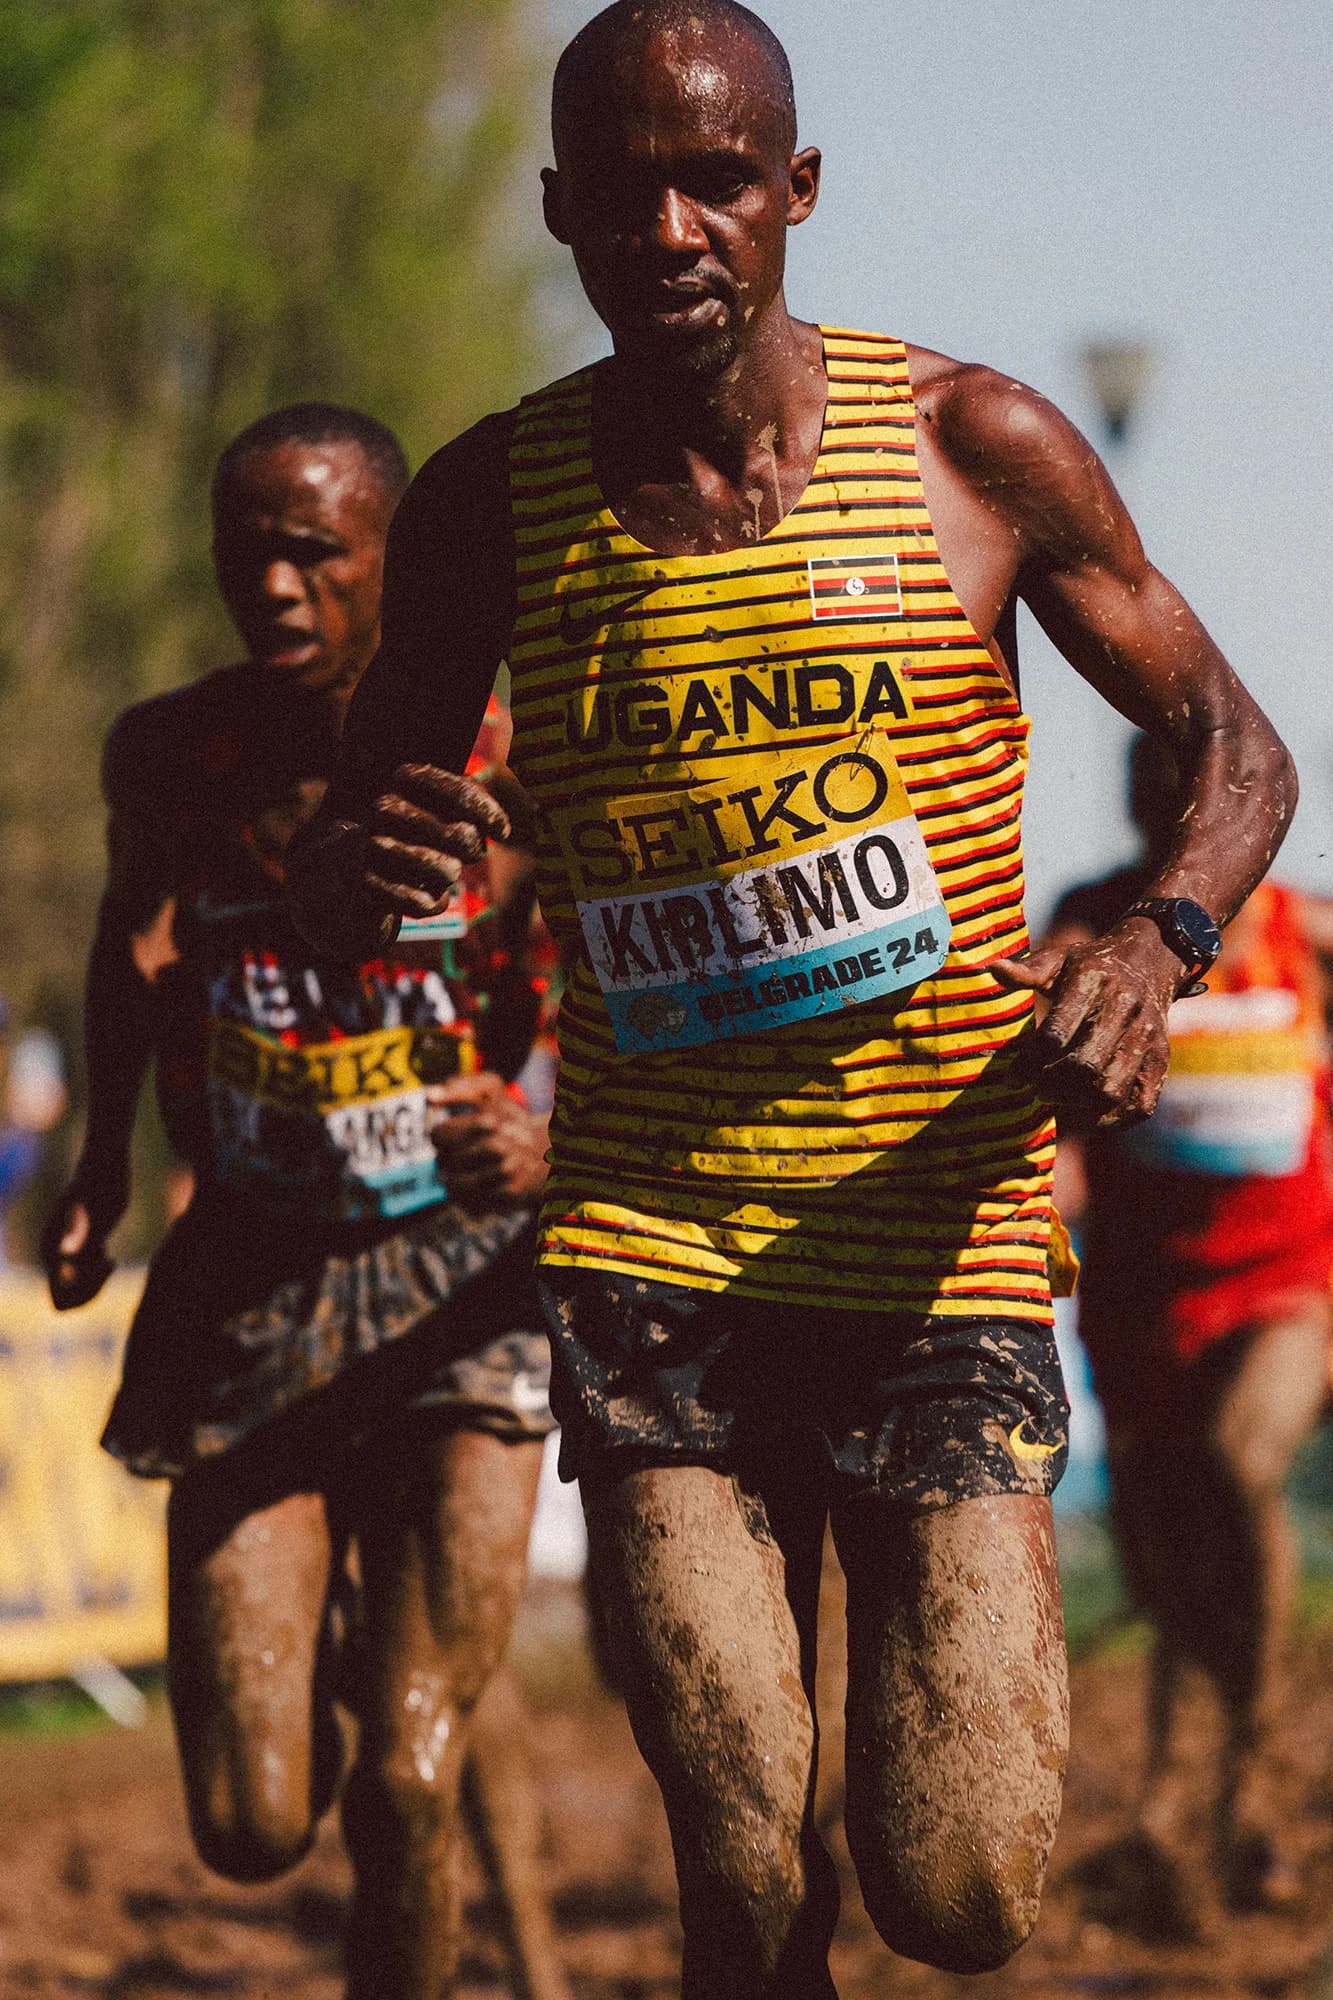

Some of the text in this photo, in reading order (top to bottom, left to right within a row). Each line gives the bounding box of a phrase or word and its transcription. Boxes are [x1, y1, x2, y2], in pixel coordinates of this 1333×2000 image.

[567, 661, 908, 753] UGANDA
[569, 752, 889, 887] SEIKO
[698, 927, 939, 1021] BELGRADE 24
